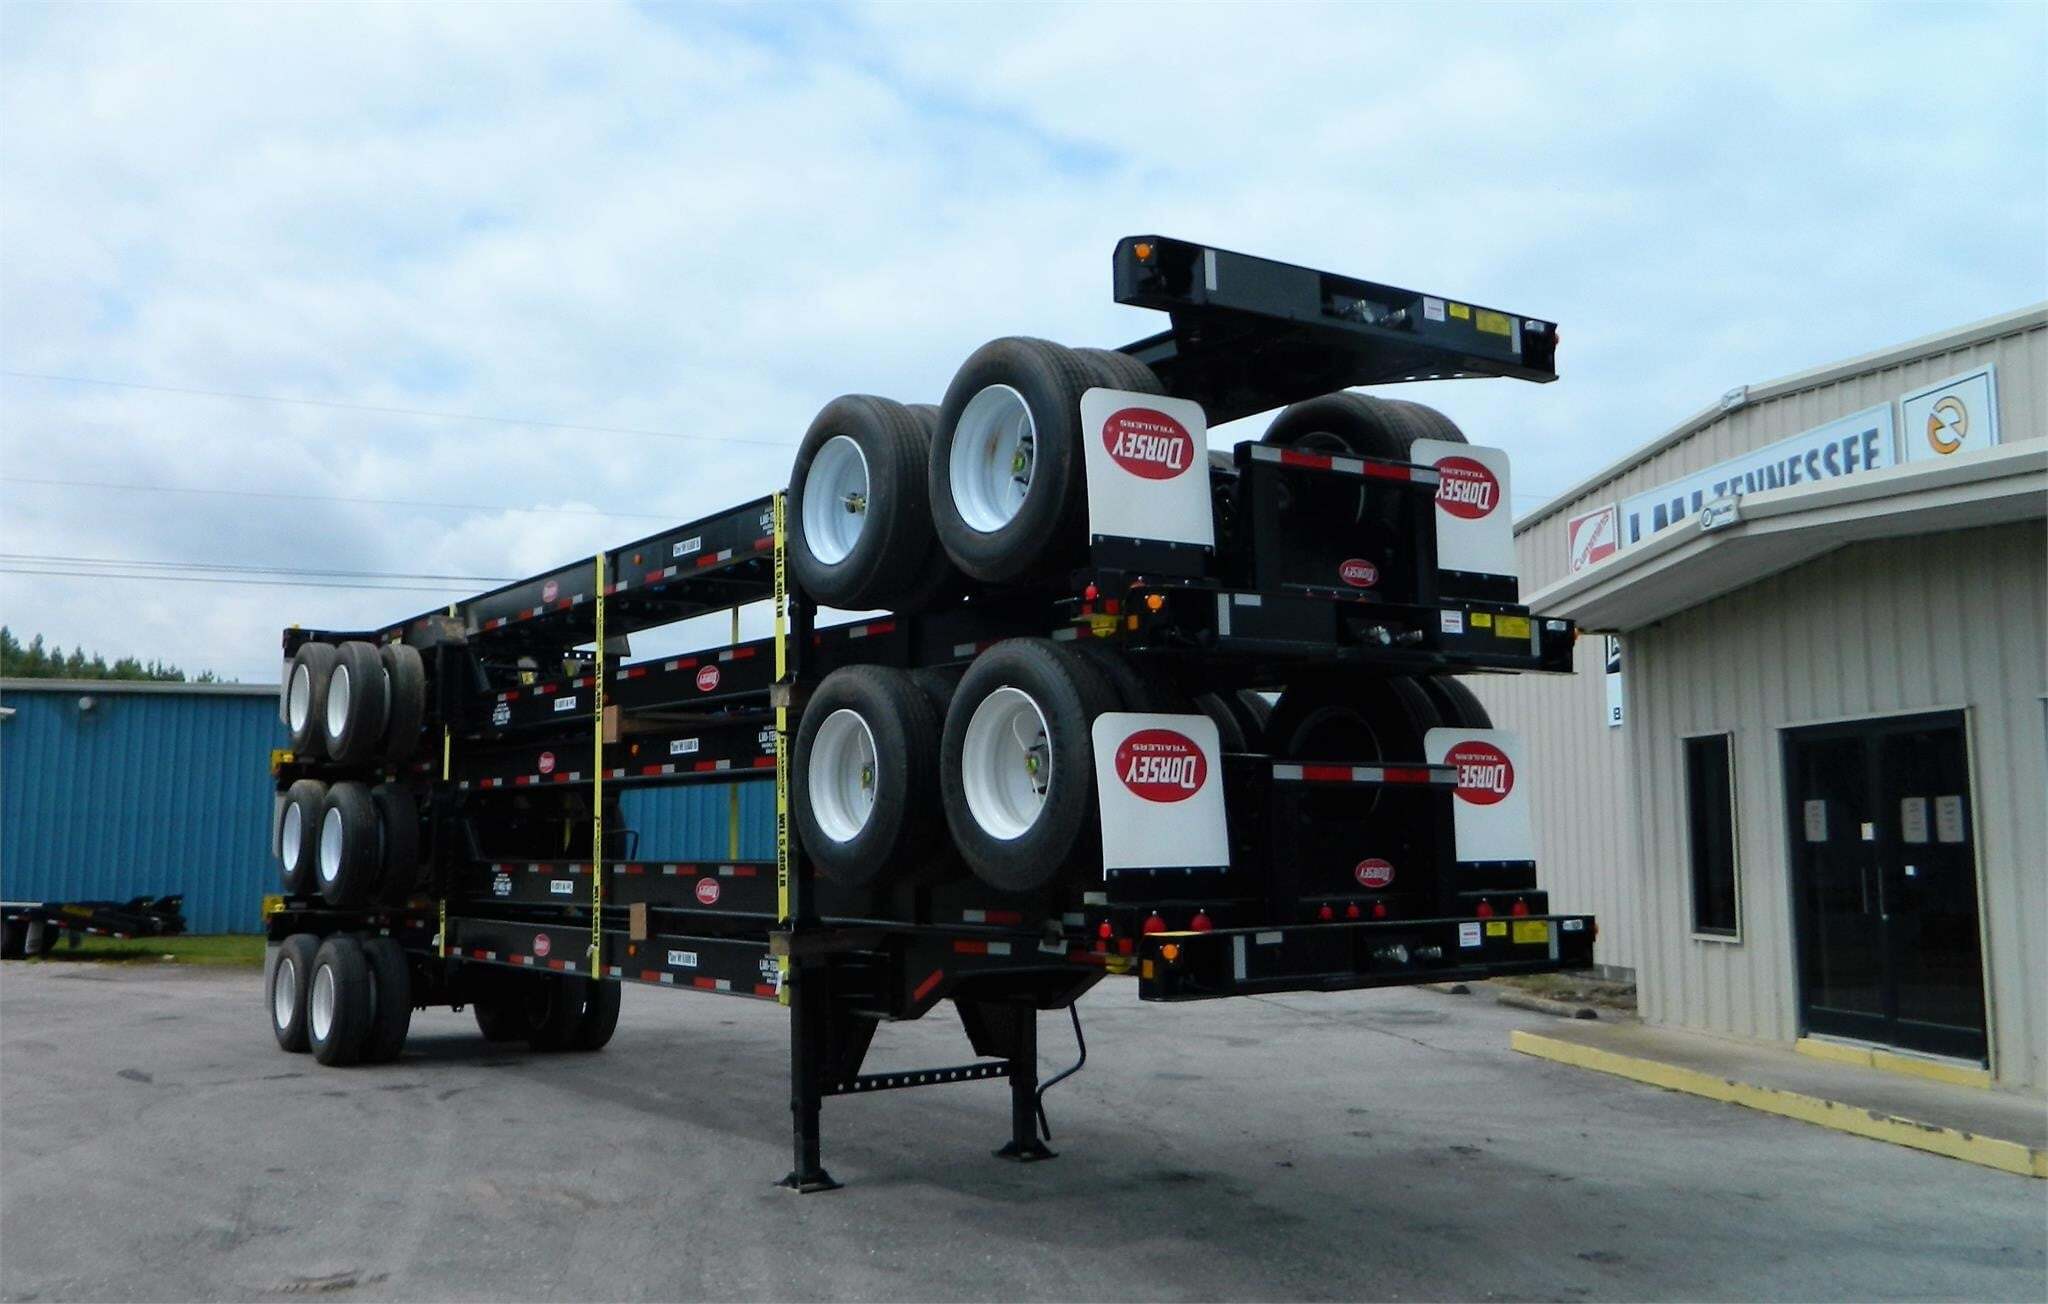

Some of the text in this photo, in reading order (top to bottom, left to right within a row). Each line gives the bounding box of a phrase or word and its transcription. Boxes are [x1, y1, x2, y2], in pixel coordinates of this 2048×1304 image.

[1120, 419, 1175, 433] TRAILERS
[1112, 431, 1184, 469] DORSEY
[1435, 477, 1491, 510] DORSEY
[1132, 743, 1187, 752] TRAILERS
[1125, 755, 1197, 788] DORSEY
[1456, 764, 1506, 793] DORSE
